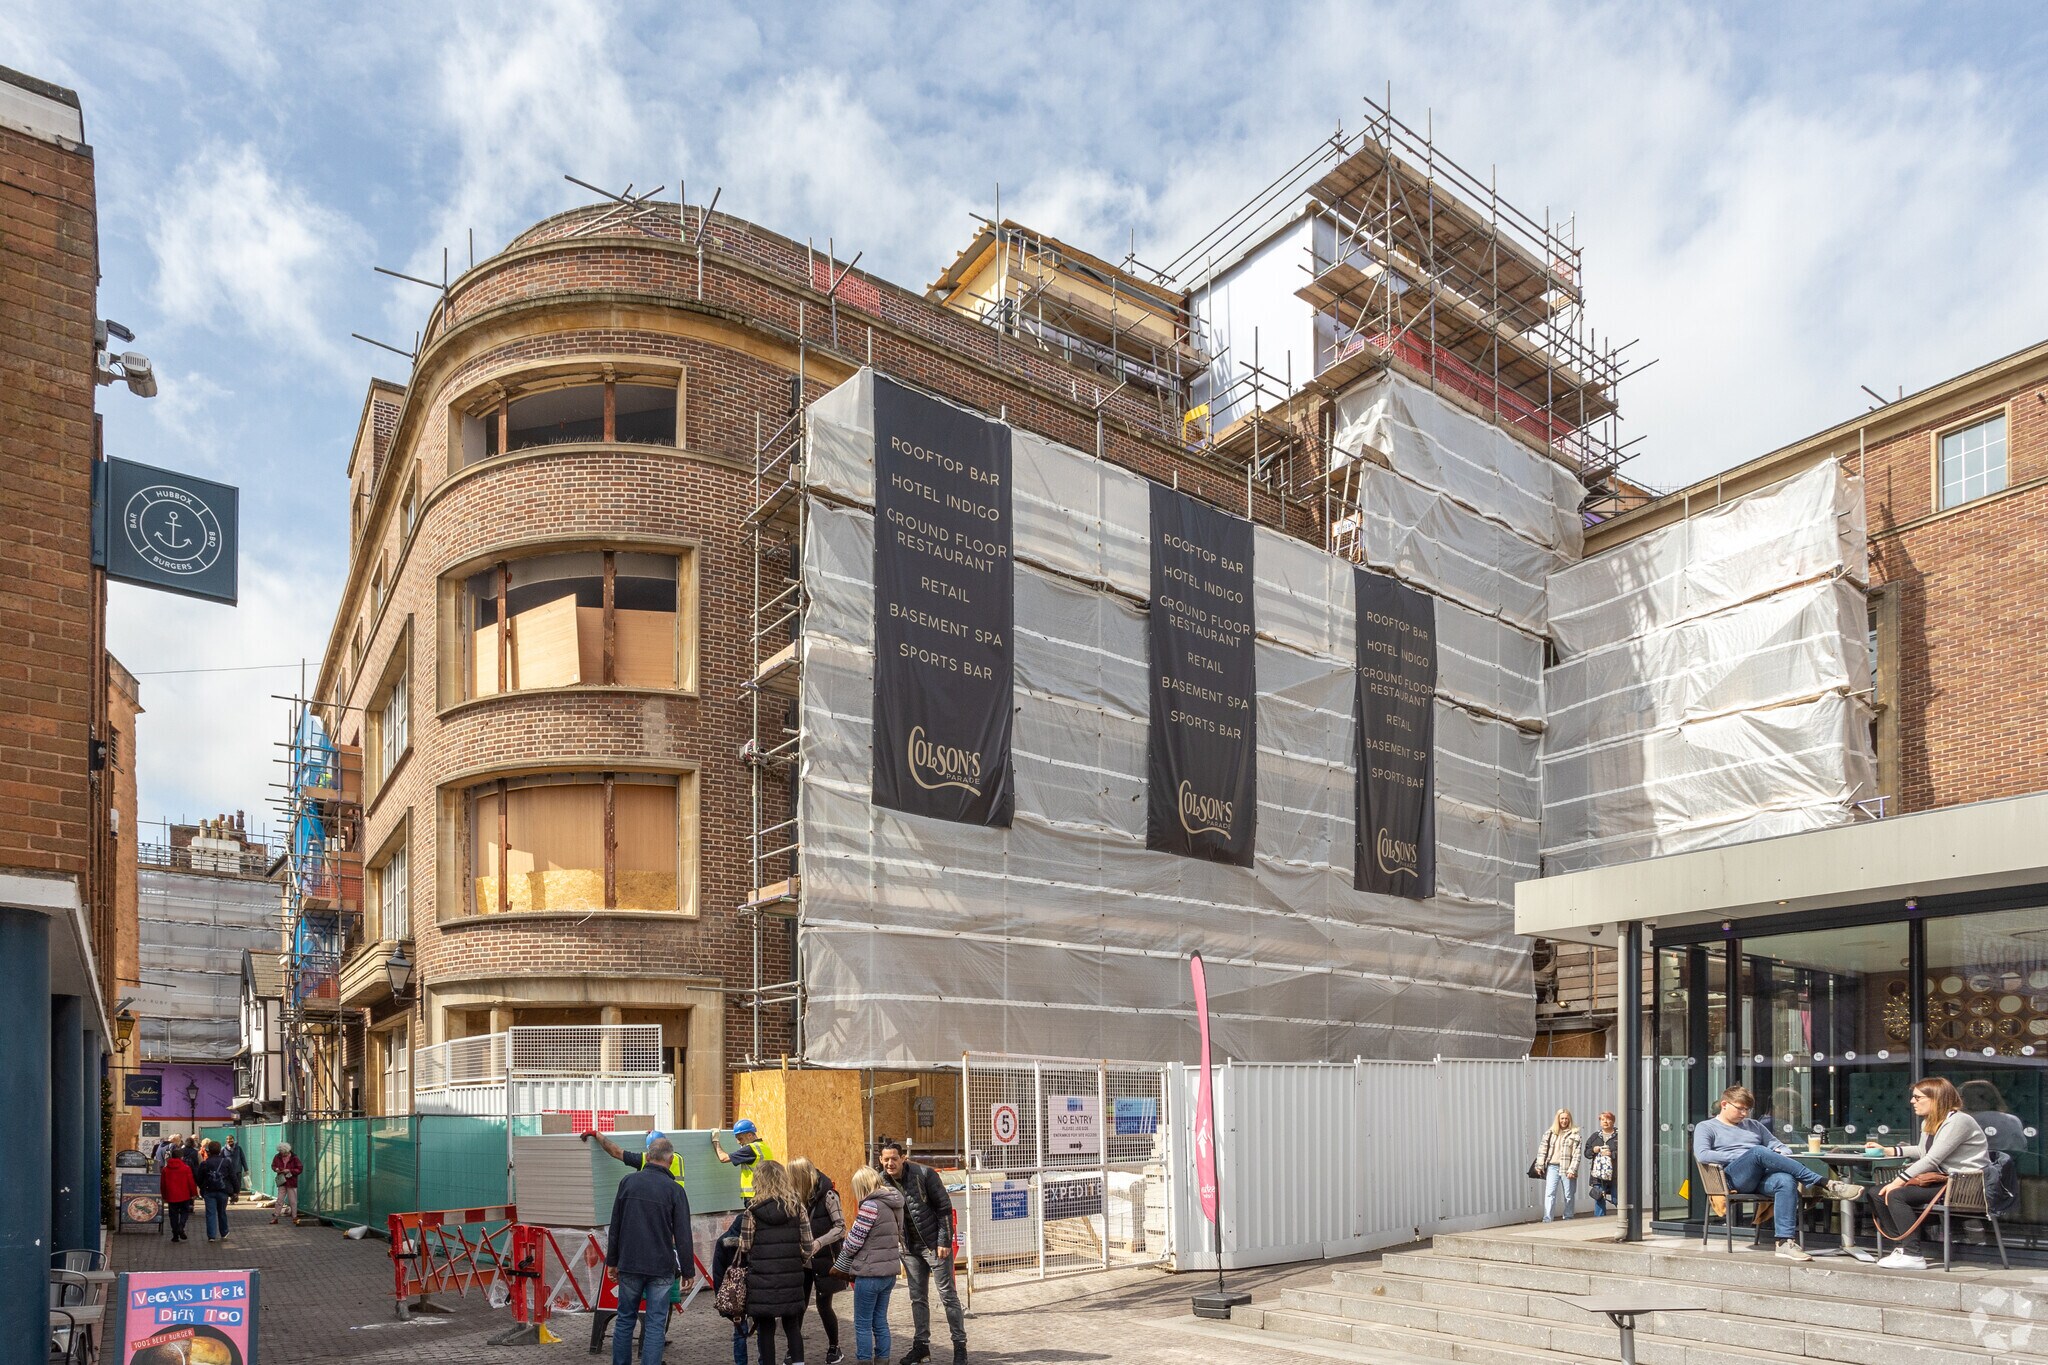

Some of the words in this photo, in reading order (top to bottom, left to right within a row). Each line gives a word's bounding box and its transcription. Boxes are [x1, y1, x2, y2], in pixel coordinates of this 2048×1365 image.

[891, 435, 964, 474] ROOFTOP
[970, 466, 1000, 486] BAR
[156, 490, 193, 505] HUBBOX
[892, 472, 940, 504] HOTEL
[946, 493, 1000, 522] INDIGO
[129, 513, 137, 529] BAR
[886, 507, 949, 542] GROUND
[955, 533, 1007, 558] FLOOR
[208, 531, 216, 547] BBQ
[897, 531, 994, 574] RESTAURANT
[1164, 533, 1217, 564] ROOFTOP
[1221, 557, 1244, 574] BAR
[153, 555, 193, 570] BURGERS
[921, 576, 970, 603] RETAIL
[1164, 565, 1200, 590] HOTEL
[1204, 581, 1243, 604] INDIGO
[890, 603, 969, 638] BASEMENT
[975, 629, 1002, 647] SPA
[1159, 595, 1207, 622] GROUND
[1211, 614, 1250, 636] FLOOR
[1366, 611, 1410, 633] ROOFTOP
[1412, 626, 1429, 641] BAR
[1169, 614, 1240, 649] RESTAURANT
[900, 643, 957, 671] SPORTS
[963, 661, 992, 680] BAR
[1187, 652, 1223, 674] RETAIL
[1367, 639, 1398, 657] HOTEL
[1401, 649, 1429, 668] INDIGO
[1162, 676, 1223, 704] BASEMENT
[1227, 696, 1248, 710] SPA
[1362, 666, 1402, 686] GROUND
[1404, 678, 1434, 696] FLOOR
[1370, 682, 1426, 708] RESTAURANT
[1170, 710, 1215, 733] SPORTS
[1219, 723, 1241, 740] BAR
[1386, 714, 1412, 732] RETAIL
[908, 725, 981, 797] COLSON'S
[1413, 750, 1426, 761] SP
[946, 773, 981, 785] PARADE
[1371, 767, 1405, 785] SPORTS
[1179, 779, 1233, 841] COLSON'S
[1002, 1114, 1010, 1134] 5
[1057, 1115, 1068, 1125] NO
[1070, 1115, 1093, 1125] ENTRY
[232, 1285, 244, 1297] It
[151, 1335, 166, 1345] BEEF
[168, 1329, 193, 1341] BURGER
